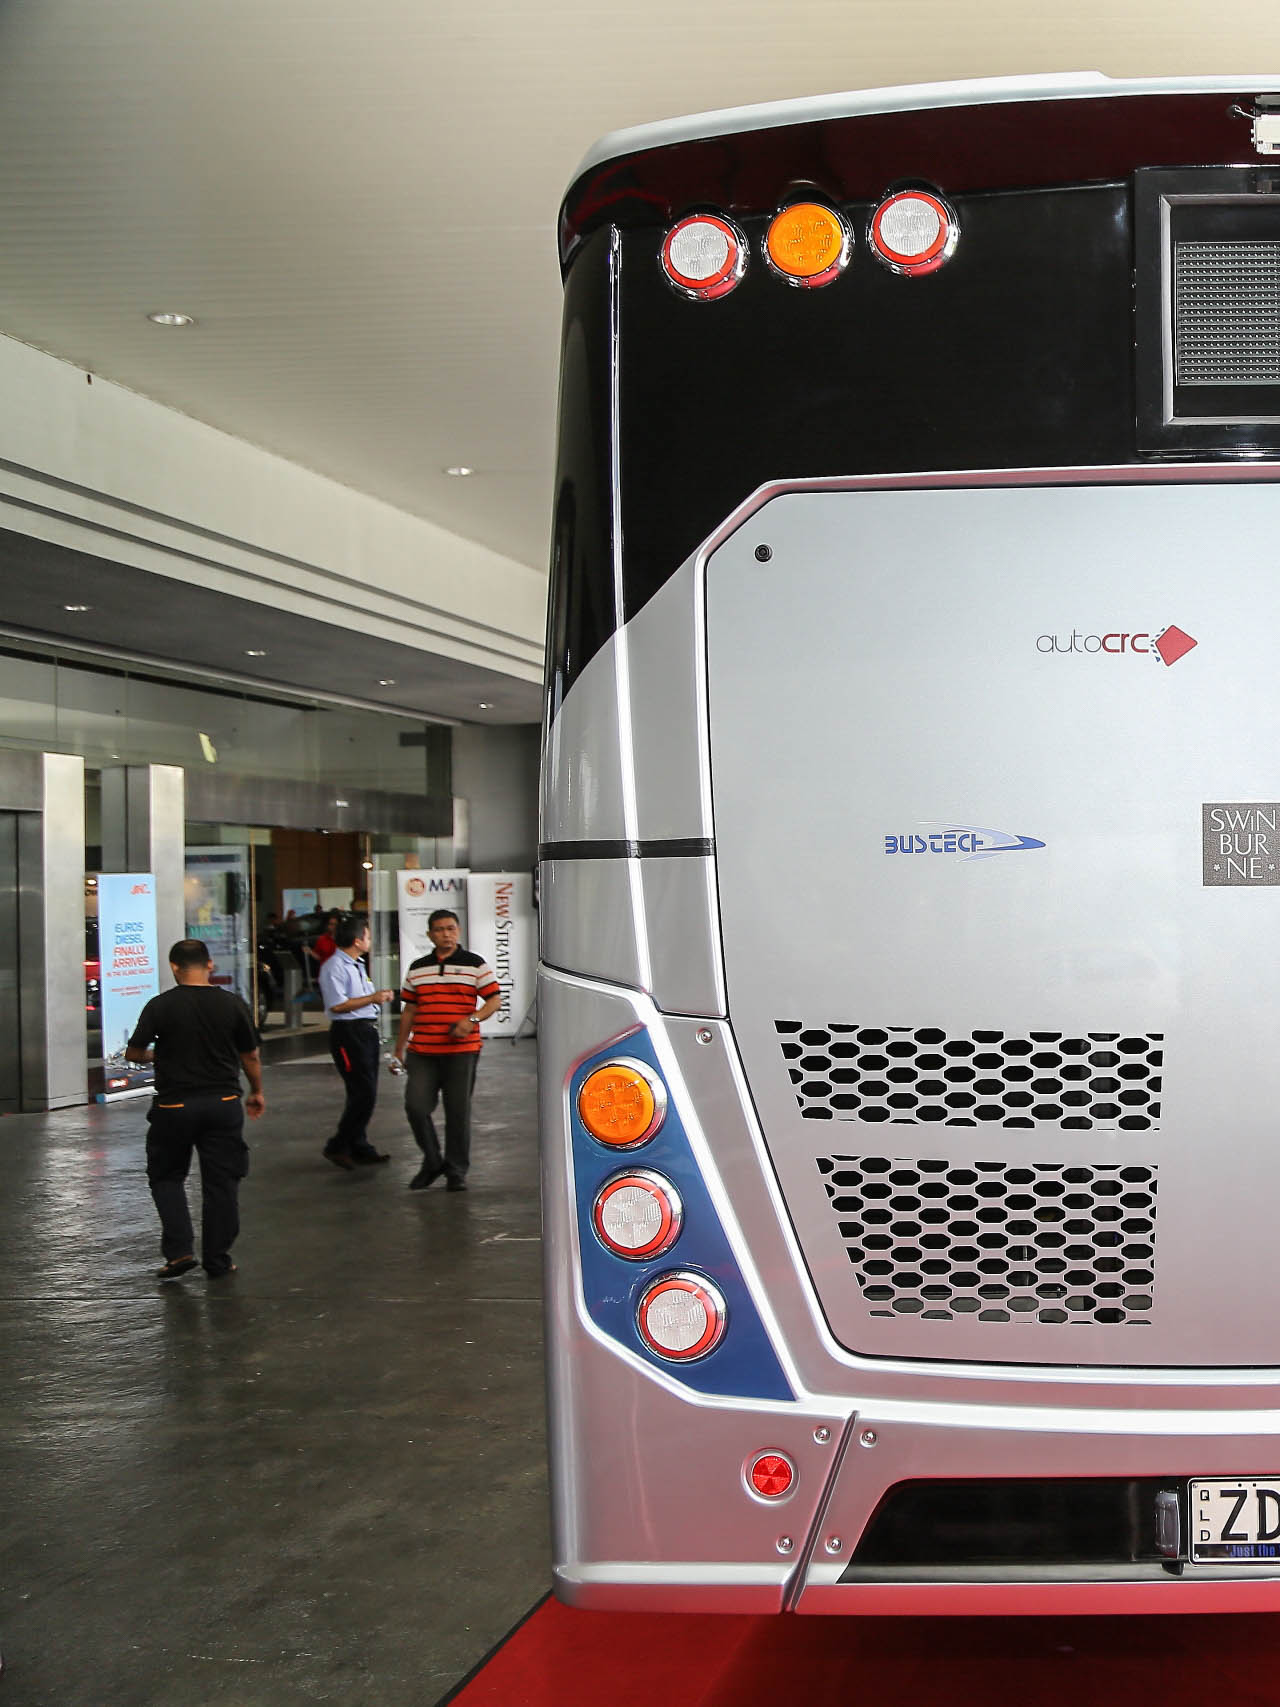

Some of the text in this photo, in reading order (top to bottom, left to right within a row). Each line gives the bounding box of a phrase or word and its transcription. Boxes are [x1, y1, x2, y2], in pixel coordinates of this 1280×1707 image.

[1036, 628, 1150, 653] autocrc
[884, 833, 984, 854] BUSTECH
[1220, 833, 1270, 856] BUR
[1226, 857, 1264, 879] NE
[495, 882, 513, 919] NEW
[495, 920, 513, 980] STRAITS
[497, 978, 515, 1024] TIMES
[1258, 1544, 1276, 1557] the
